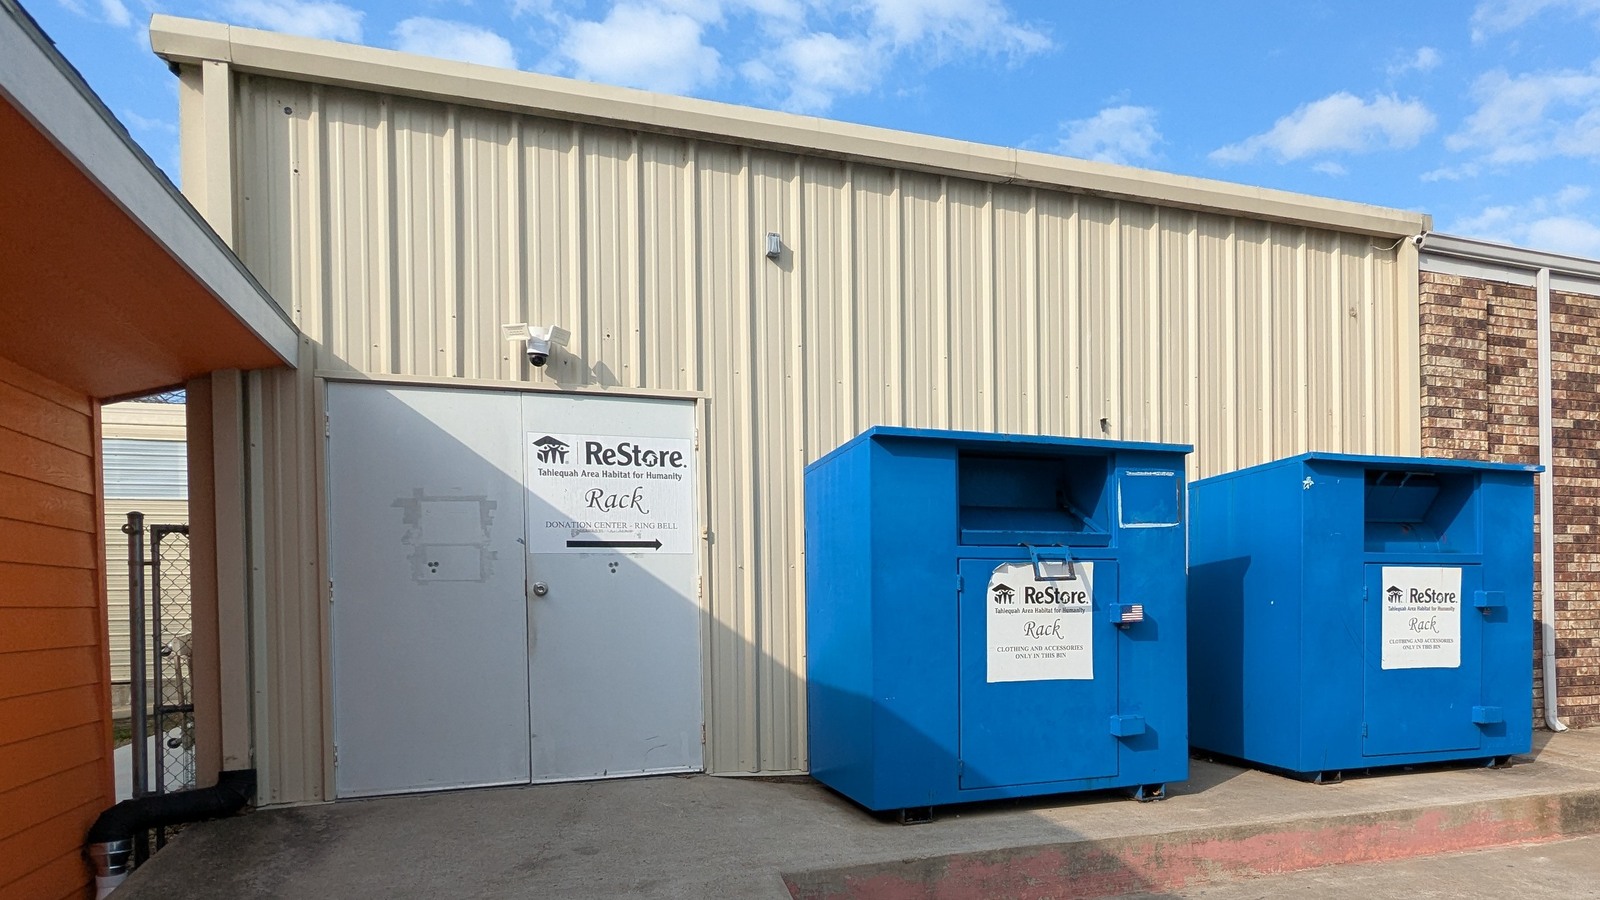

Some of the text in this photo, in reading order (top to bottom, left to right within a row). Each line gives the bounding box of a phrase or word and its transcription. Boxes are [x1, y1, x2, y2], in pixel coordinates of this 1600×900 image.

[538, 468, 682, 481] Tahlequah Area Habitat for Humanity
[585, 486, 649, 514] Rack
[1024, 619, 1064, 639] Rack
[1409, 616, 1439, 633] Rack
